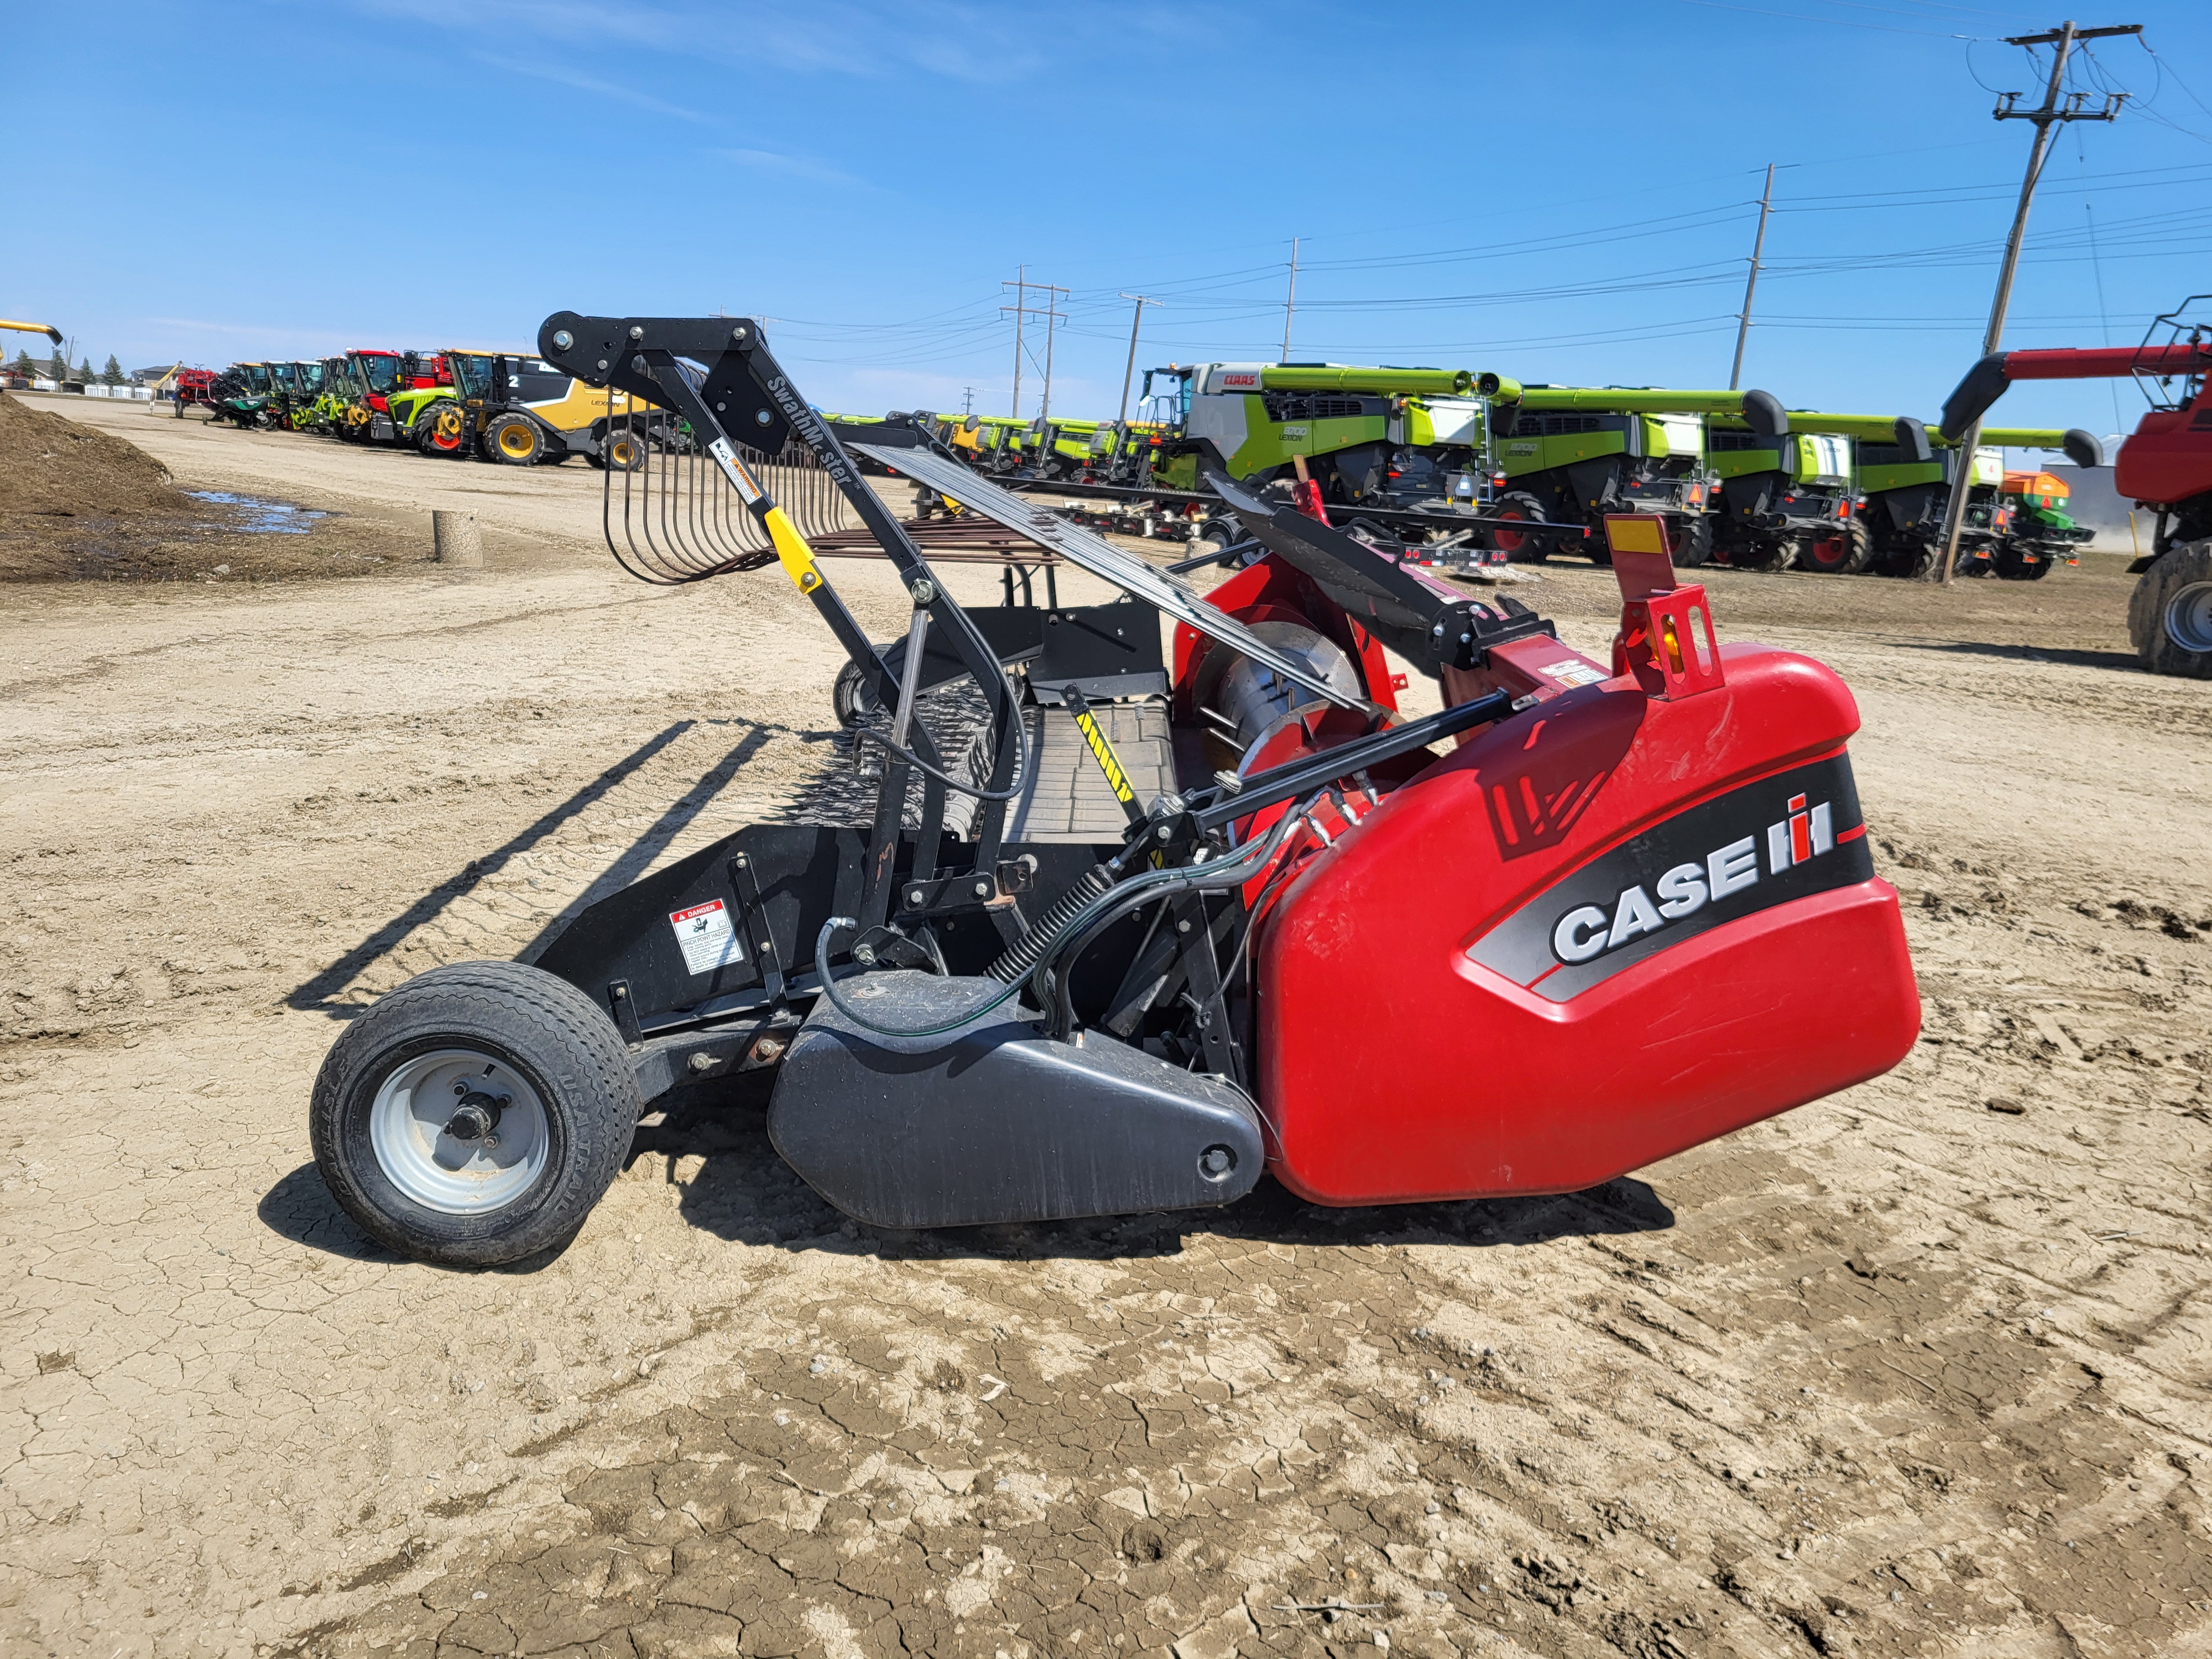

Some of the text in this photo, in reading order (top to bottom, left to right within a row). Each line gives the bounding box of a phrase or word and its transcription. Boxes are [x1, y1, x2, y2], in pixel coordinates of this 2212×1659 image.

[508, 375, 519, 388] 2
[1224, 375, 1255, 385] CLAAS
[591, 399, 620, 408] LEXIN
[1284, 426, 1307, 435] 8700
[738, 468, 757, 493] WARNING
[1554, 834, 1760, 962] CASE
[687, 904, 716, 917] DANGER
[711, 928, 730, 938] HAZARD
[554, 1074, 591, 1212] USA TRAIL
